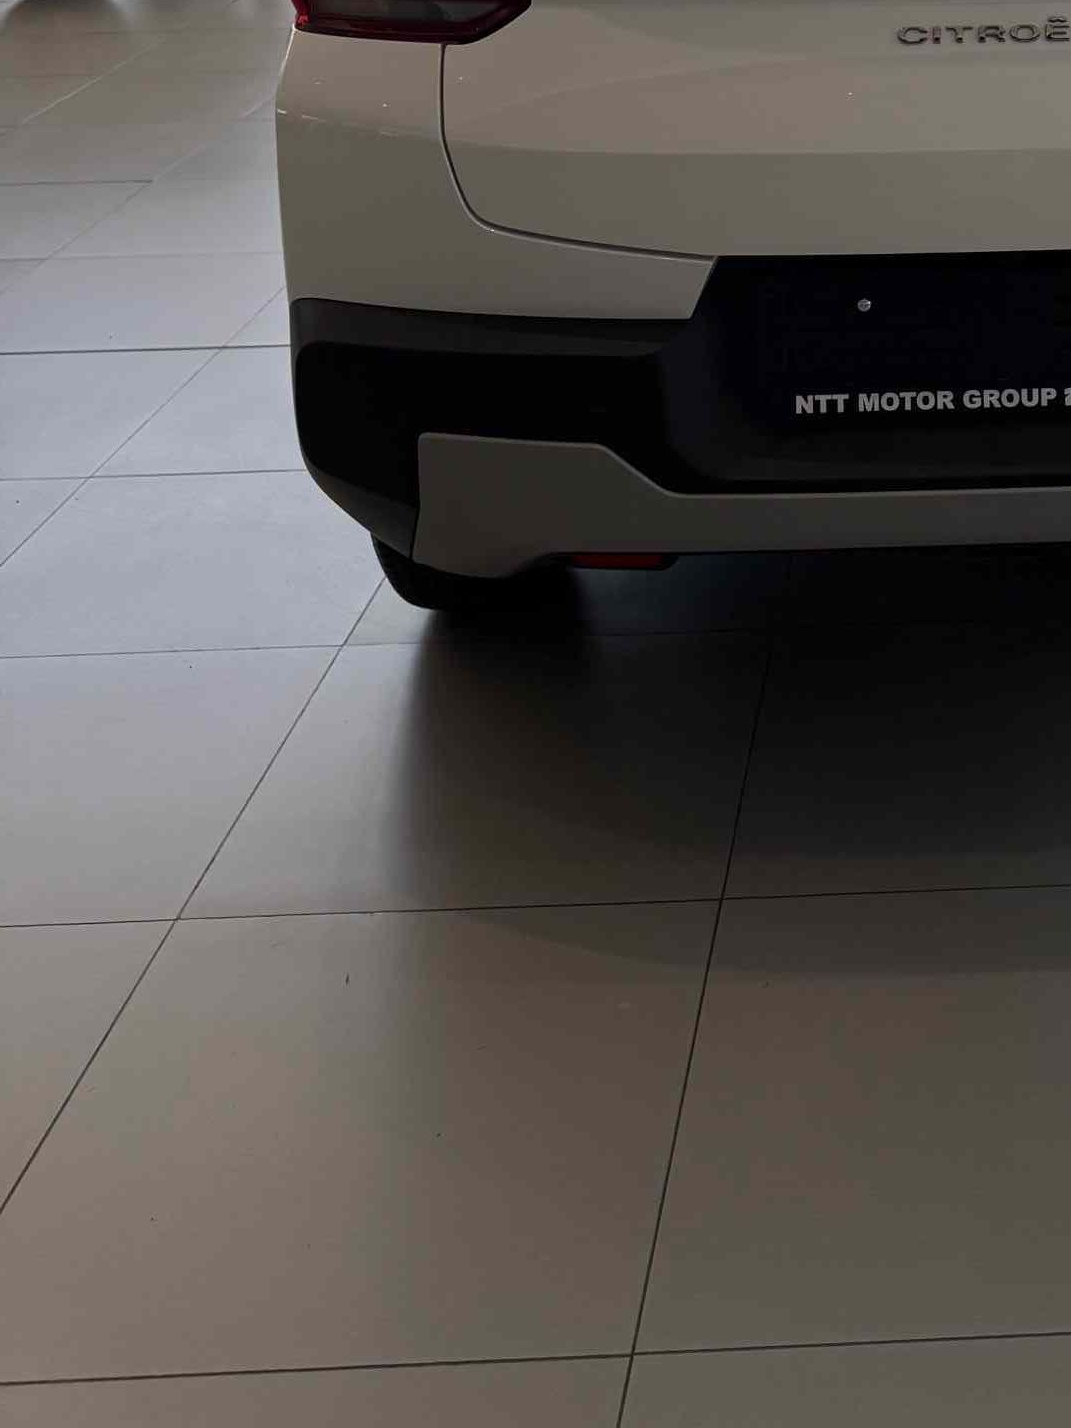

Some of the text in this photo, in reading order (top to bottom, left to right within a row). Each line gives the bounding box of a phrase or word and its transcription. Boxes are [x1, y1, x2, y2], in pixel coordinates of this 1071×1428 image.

[795, 393, 850, 414] NTT
[858, 390, 955, 412] MOTOR
[962, 387, 1057, 409] GROUP
